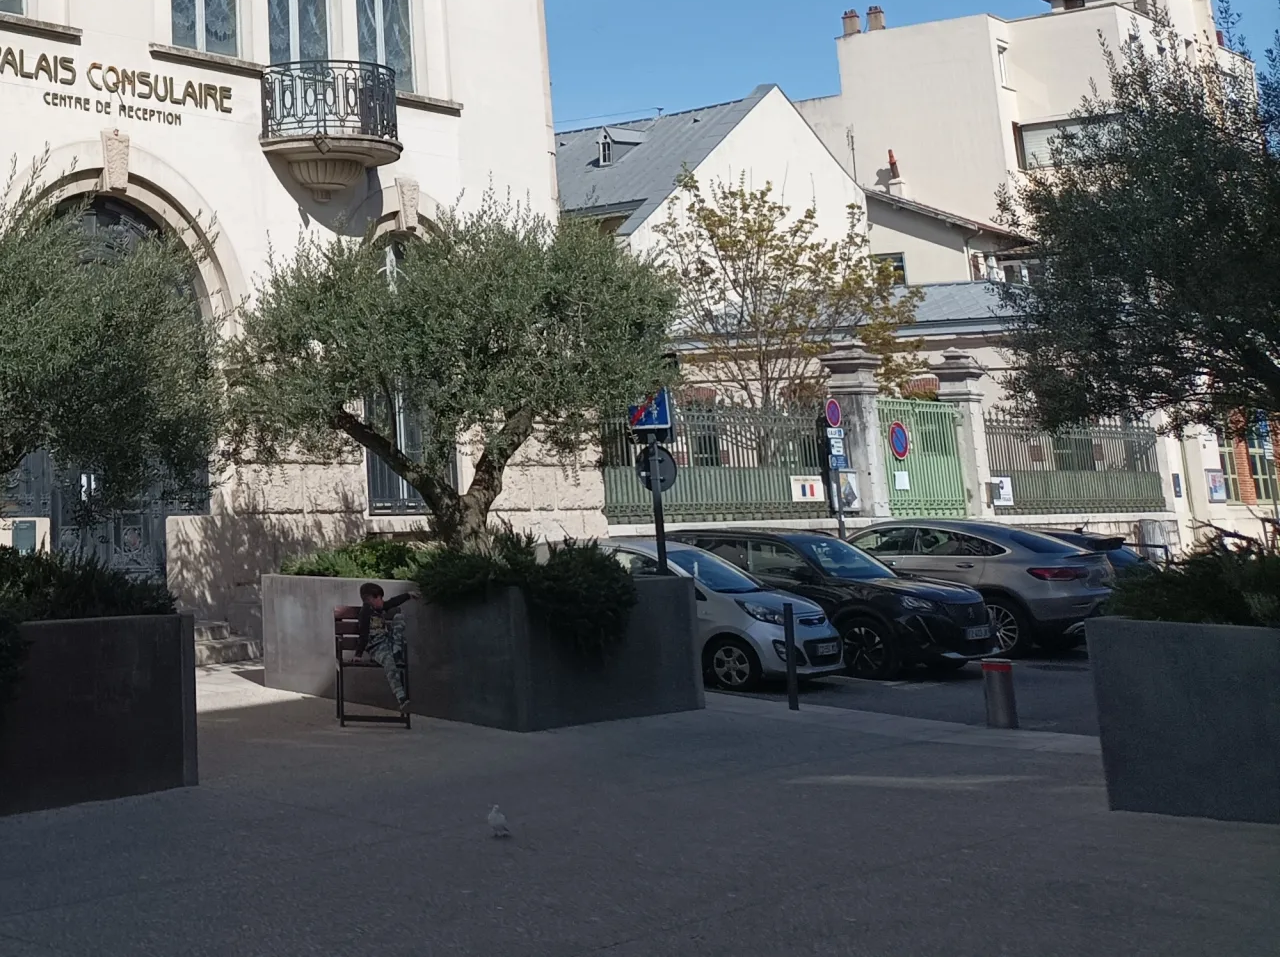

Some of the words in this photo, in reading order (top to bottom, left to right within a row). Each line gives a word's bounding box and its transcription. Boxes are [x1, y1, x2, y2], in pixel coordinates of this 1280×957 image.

[86, 62, 232, 113] CONSULAIRE
[43, 92, 90, 111] CENTRE
[96, 100, 111, 115] DE
[119, 104, 182, 126] RECEPTION
